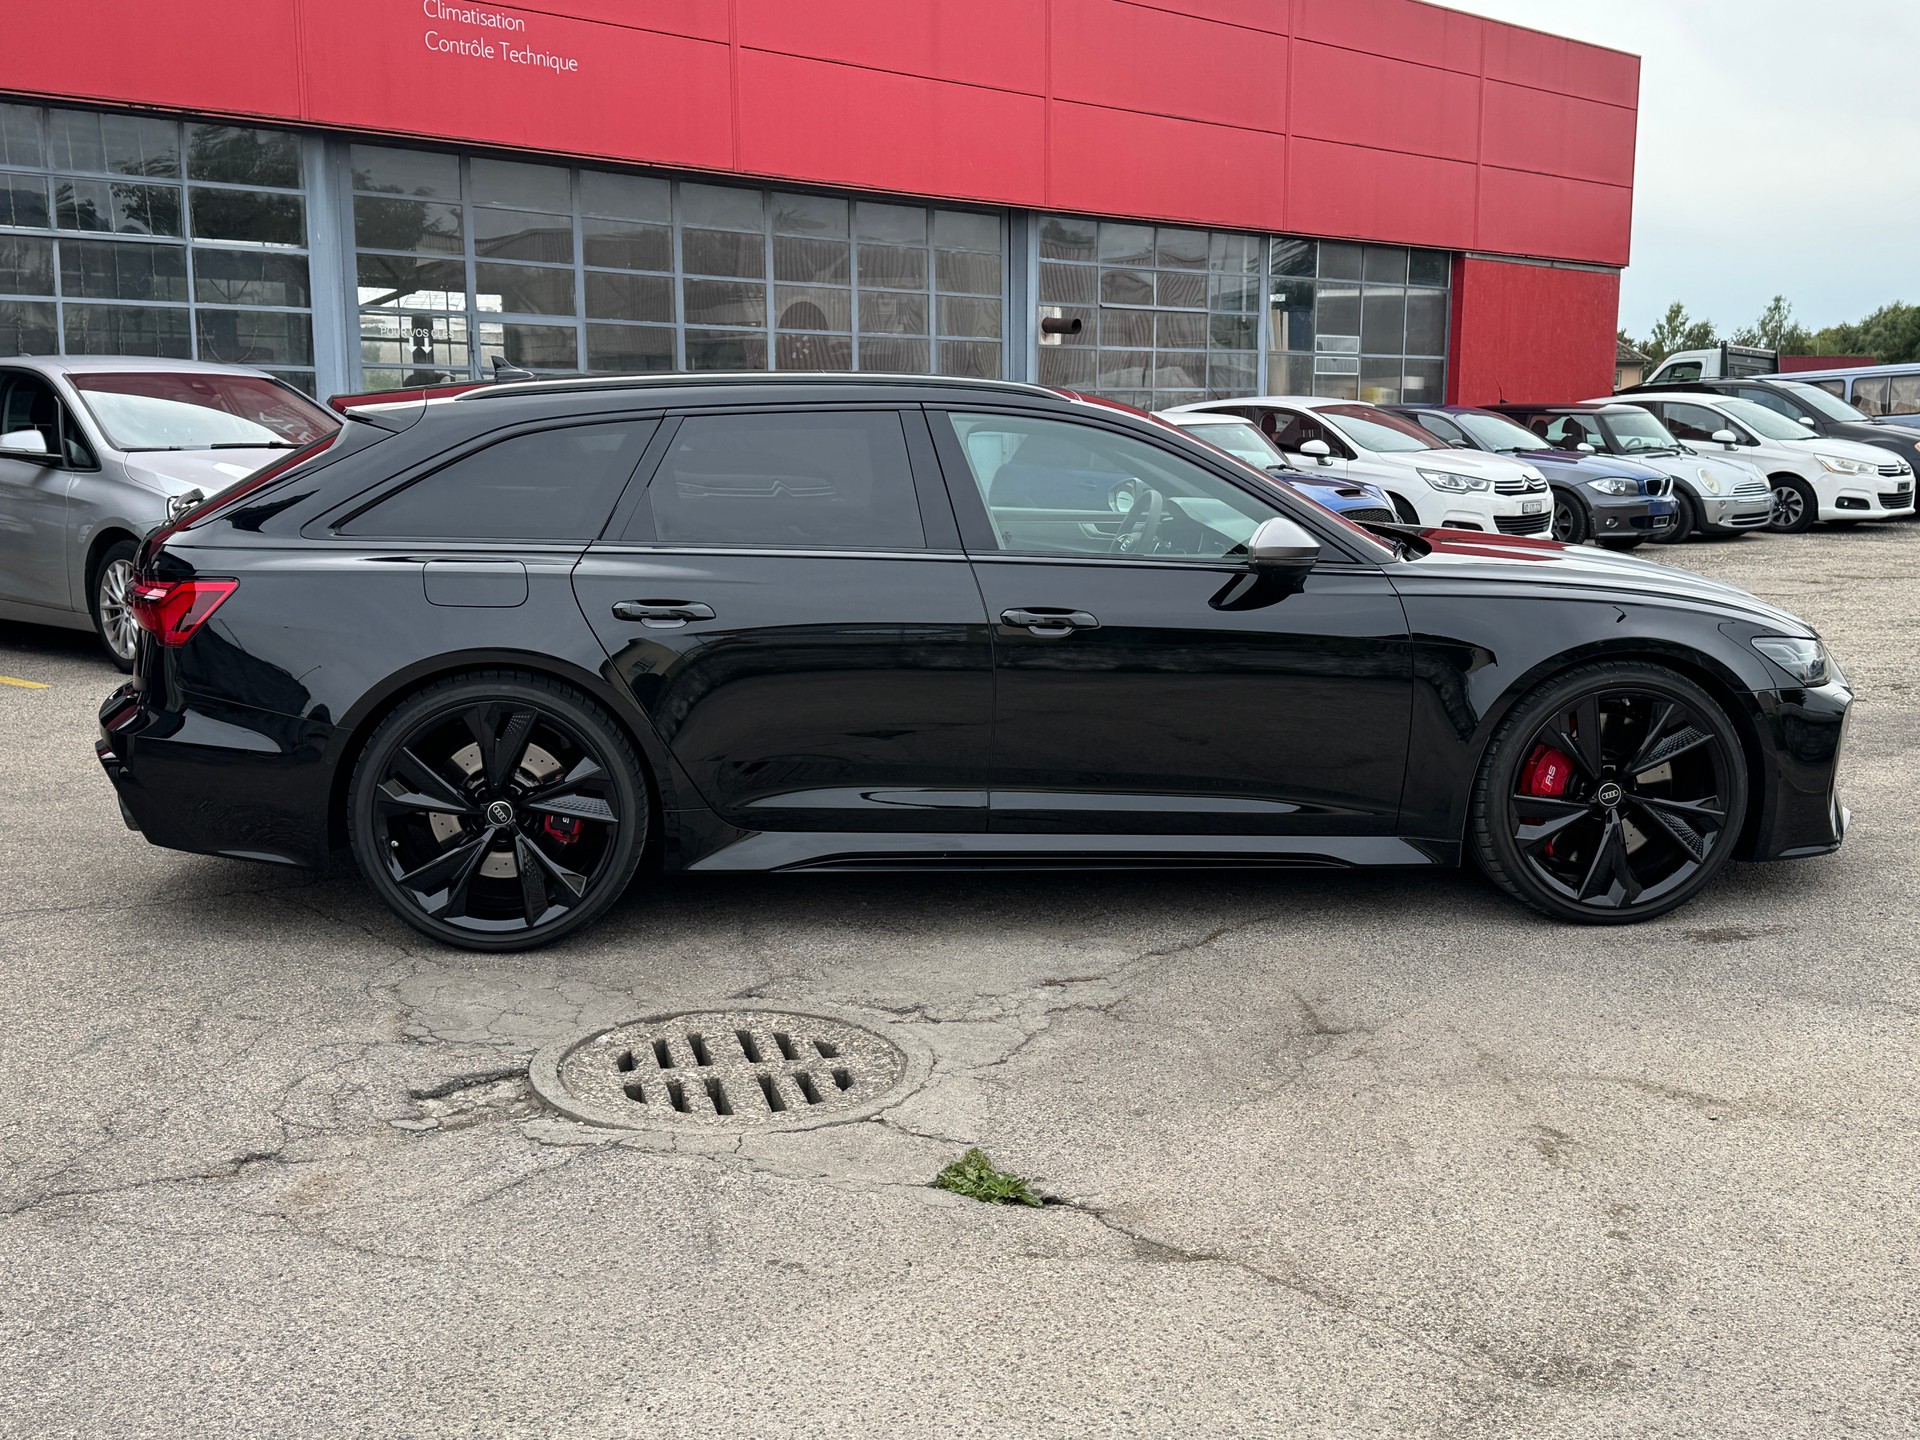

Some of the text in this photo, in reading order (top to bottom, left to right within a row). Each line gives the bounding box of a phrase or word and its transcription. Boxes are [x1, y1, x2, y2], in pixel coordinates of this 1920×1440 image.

[423, 0, 525, 32] Climatisation
[425, 31, 578, 74] Contrôle Technique
[380, 327, 408, 338] POUR
[409, 328, 429, 338] VOS
[1545, 765, 1556, 786] RS
